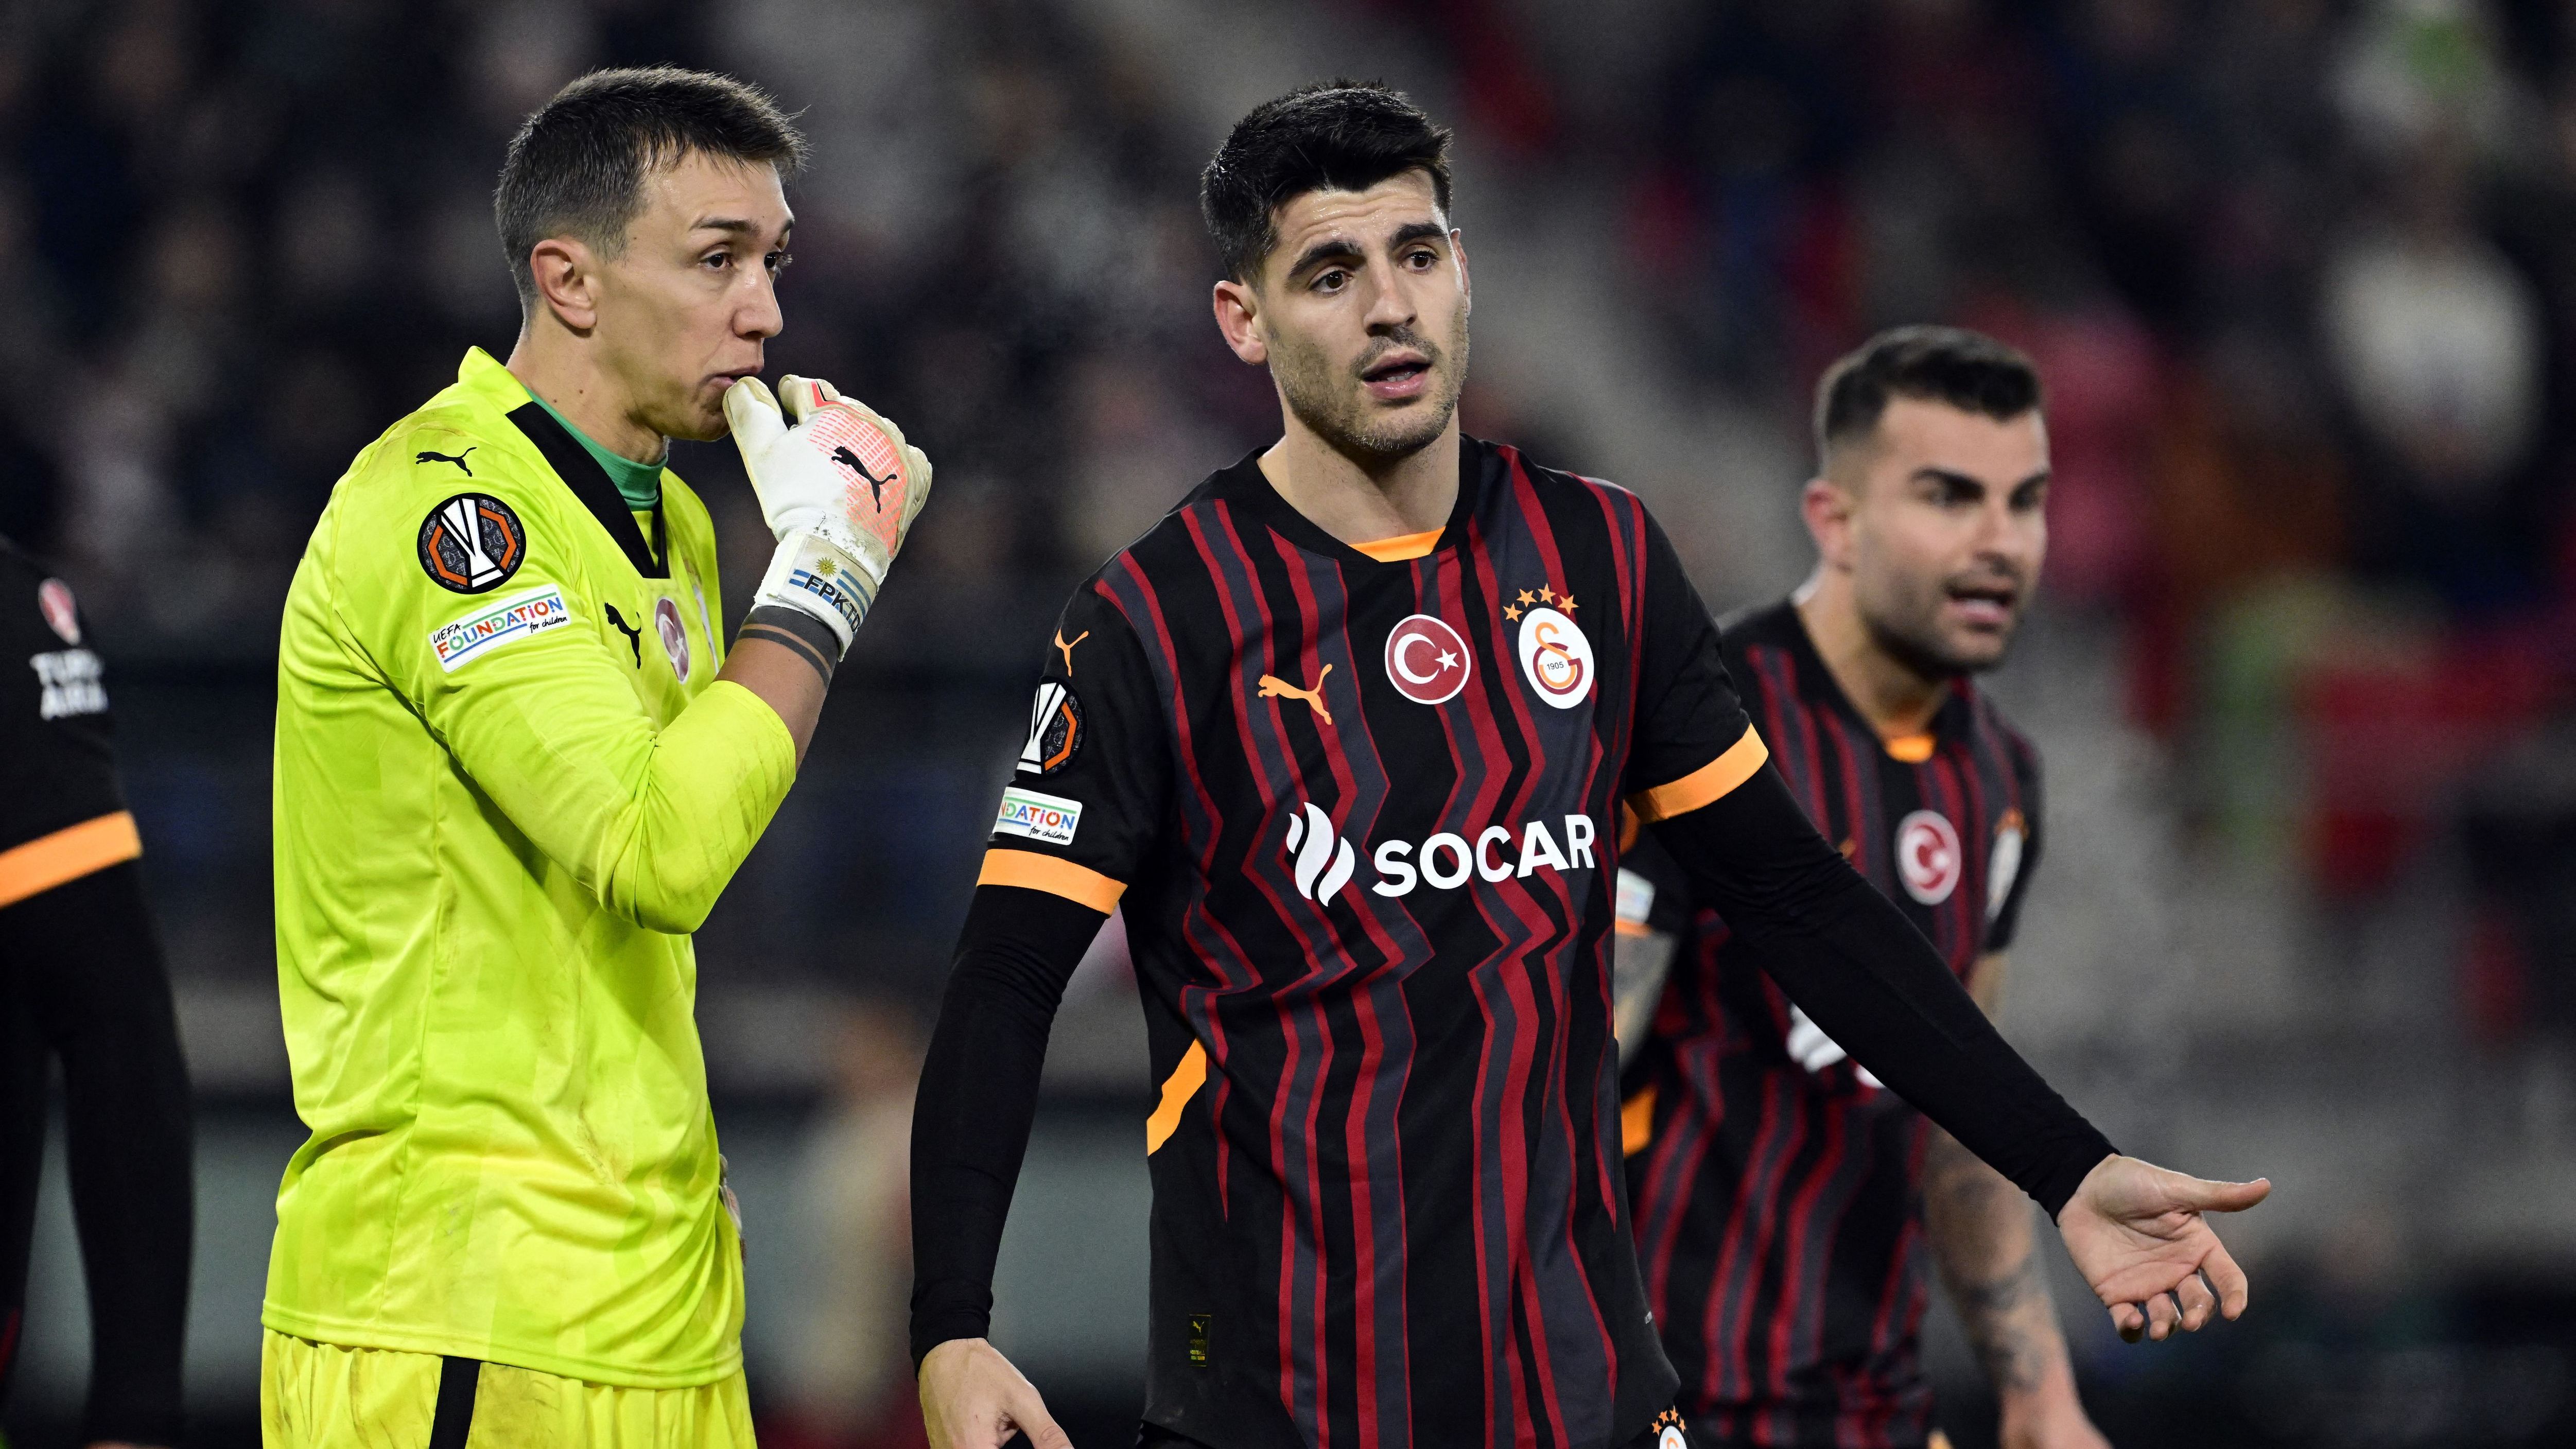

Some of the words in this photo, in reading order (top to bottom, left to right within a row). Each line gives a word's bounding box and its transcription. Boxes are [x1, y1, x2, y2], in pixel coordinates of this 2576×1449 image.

[433, 623, 461, 643] UEFA
[529, 621, 539, 633] for
[542, 617, 567, 627] children
[1547, 661, 1564, 670] 1905
[1029, 826, 1040, 836] for
[1042, 829, 1069, 841] children
[1372, 814, 1595, 897] SOCAR
